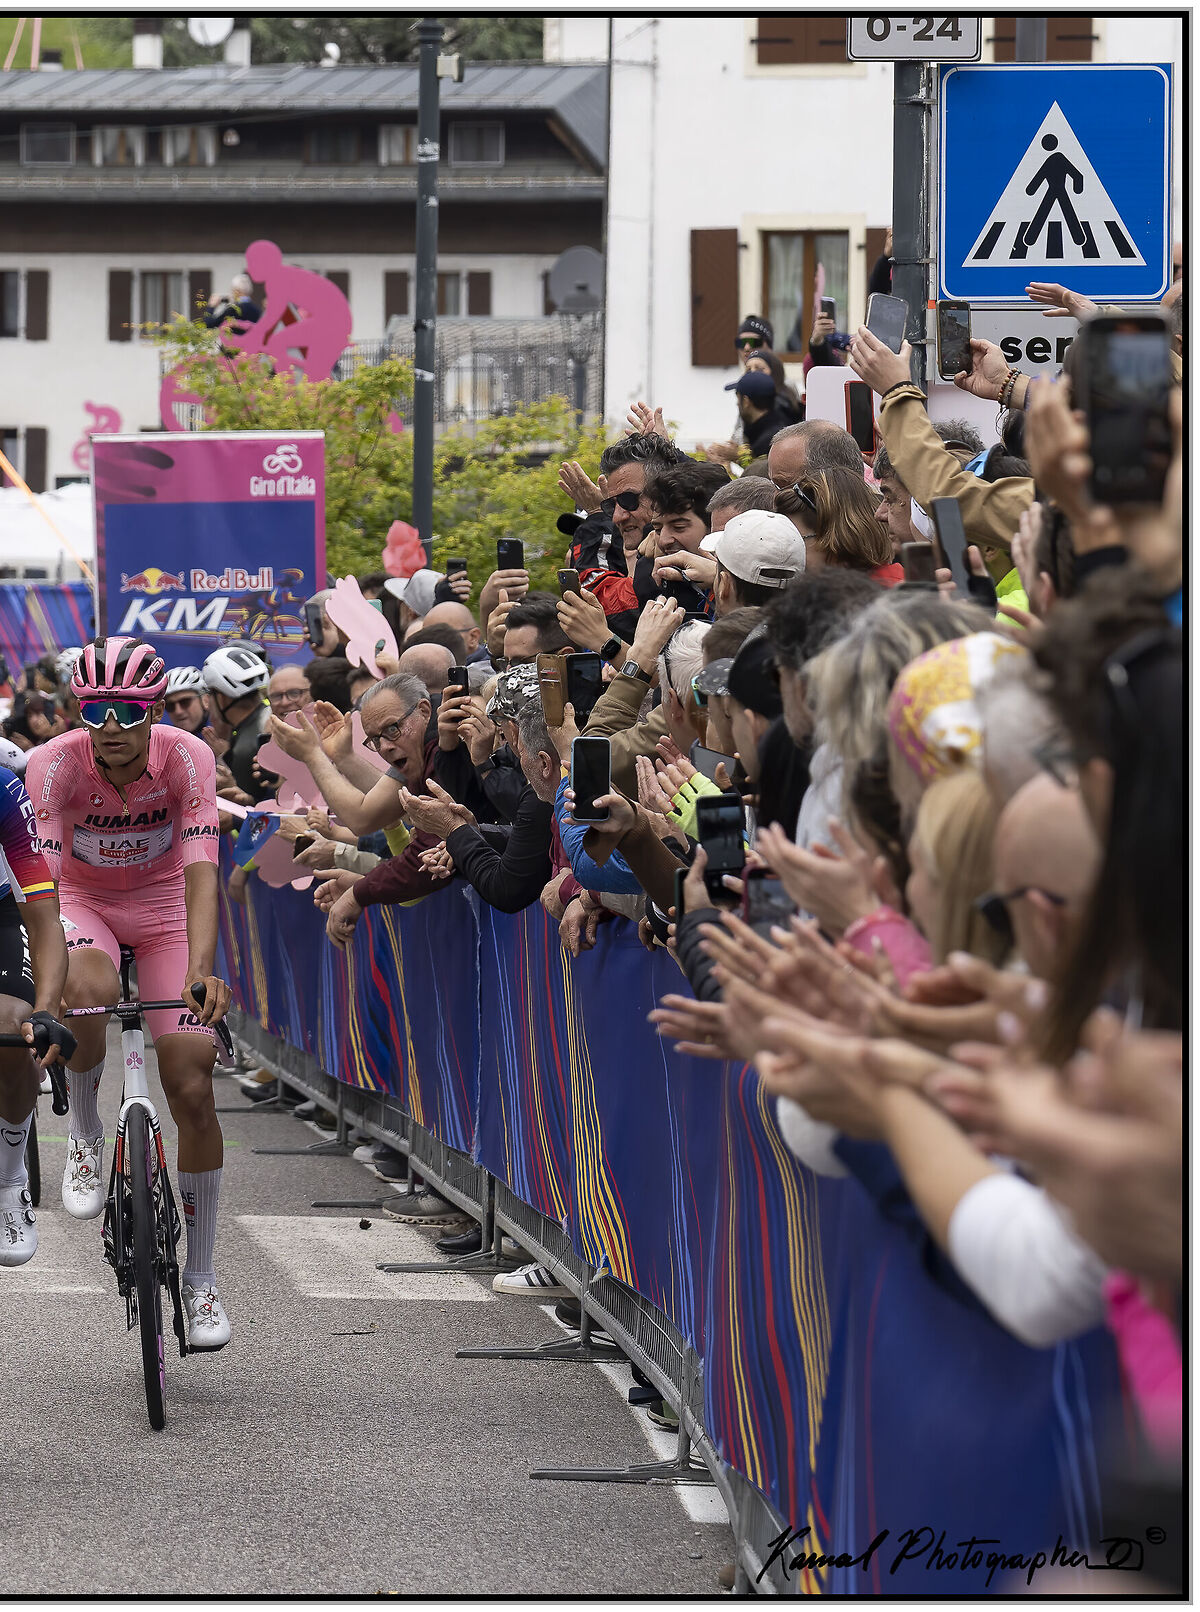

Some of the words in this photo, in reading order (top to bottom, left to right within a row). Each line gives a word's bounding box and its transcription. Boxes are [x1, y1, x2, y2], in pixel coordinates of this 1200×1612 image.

[250, 476, 275, 496] Giro
[277, 475, 316, 496] d'Italia
[191, 568, 232, 592] Red
[234, 567, 273, 592] Bull
[117, 597, 230, 633] KM
[84, 807, 168, 829] IUMAN
[99, 838, 150, 850] UAE
